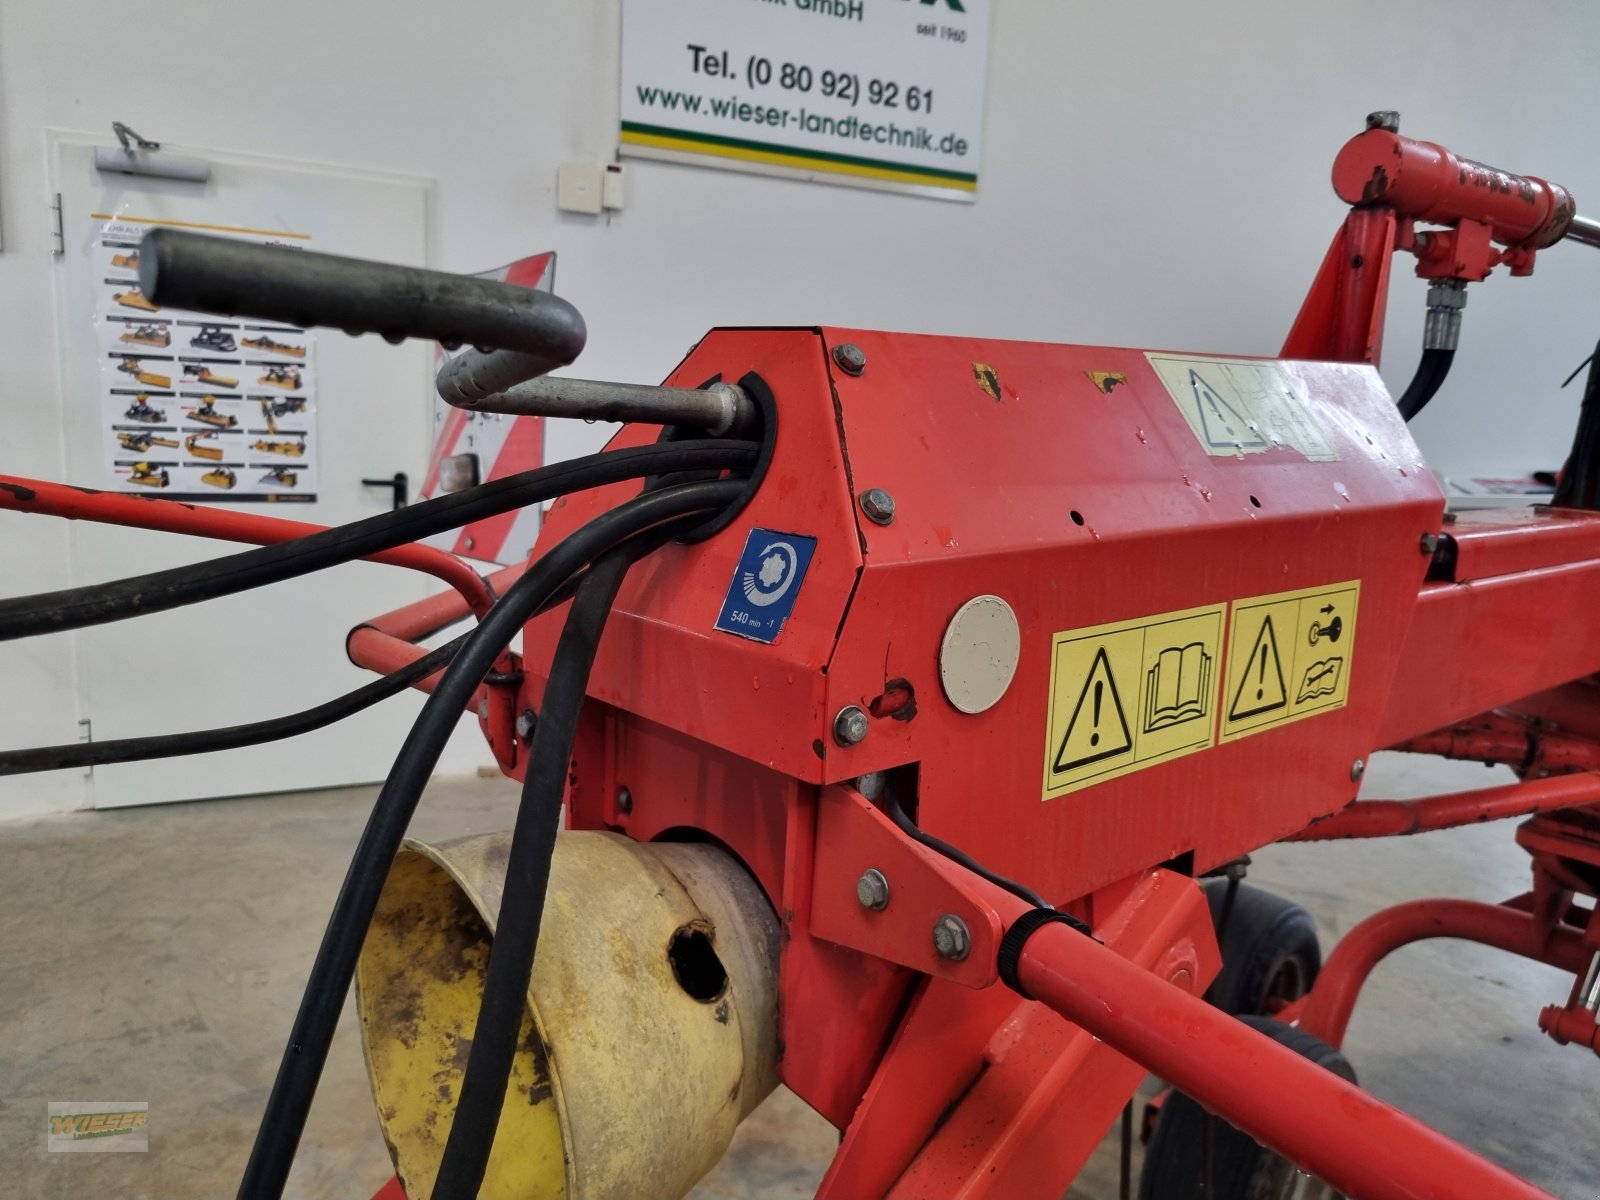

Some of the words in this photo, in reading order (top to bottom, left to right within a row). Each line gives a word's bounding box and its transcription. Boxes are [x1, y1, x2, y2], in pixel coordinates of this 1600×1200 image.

[916, 23, 937, 37] seit
[687, 44, 736, 80] Tel.
[747, 55, 772, 90] (0
[780, 62, 813, 93] 80
[821, 69, 860, 107] 92)
[868, 78, 899, 108] 92
[906, 85, 934, 115] 61
[636, 85, 969, 157] www.wieser-landtechnik.de
[731, 611, 748, 624] 540
[749, 620, 761, 628] min
